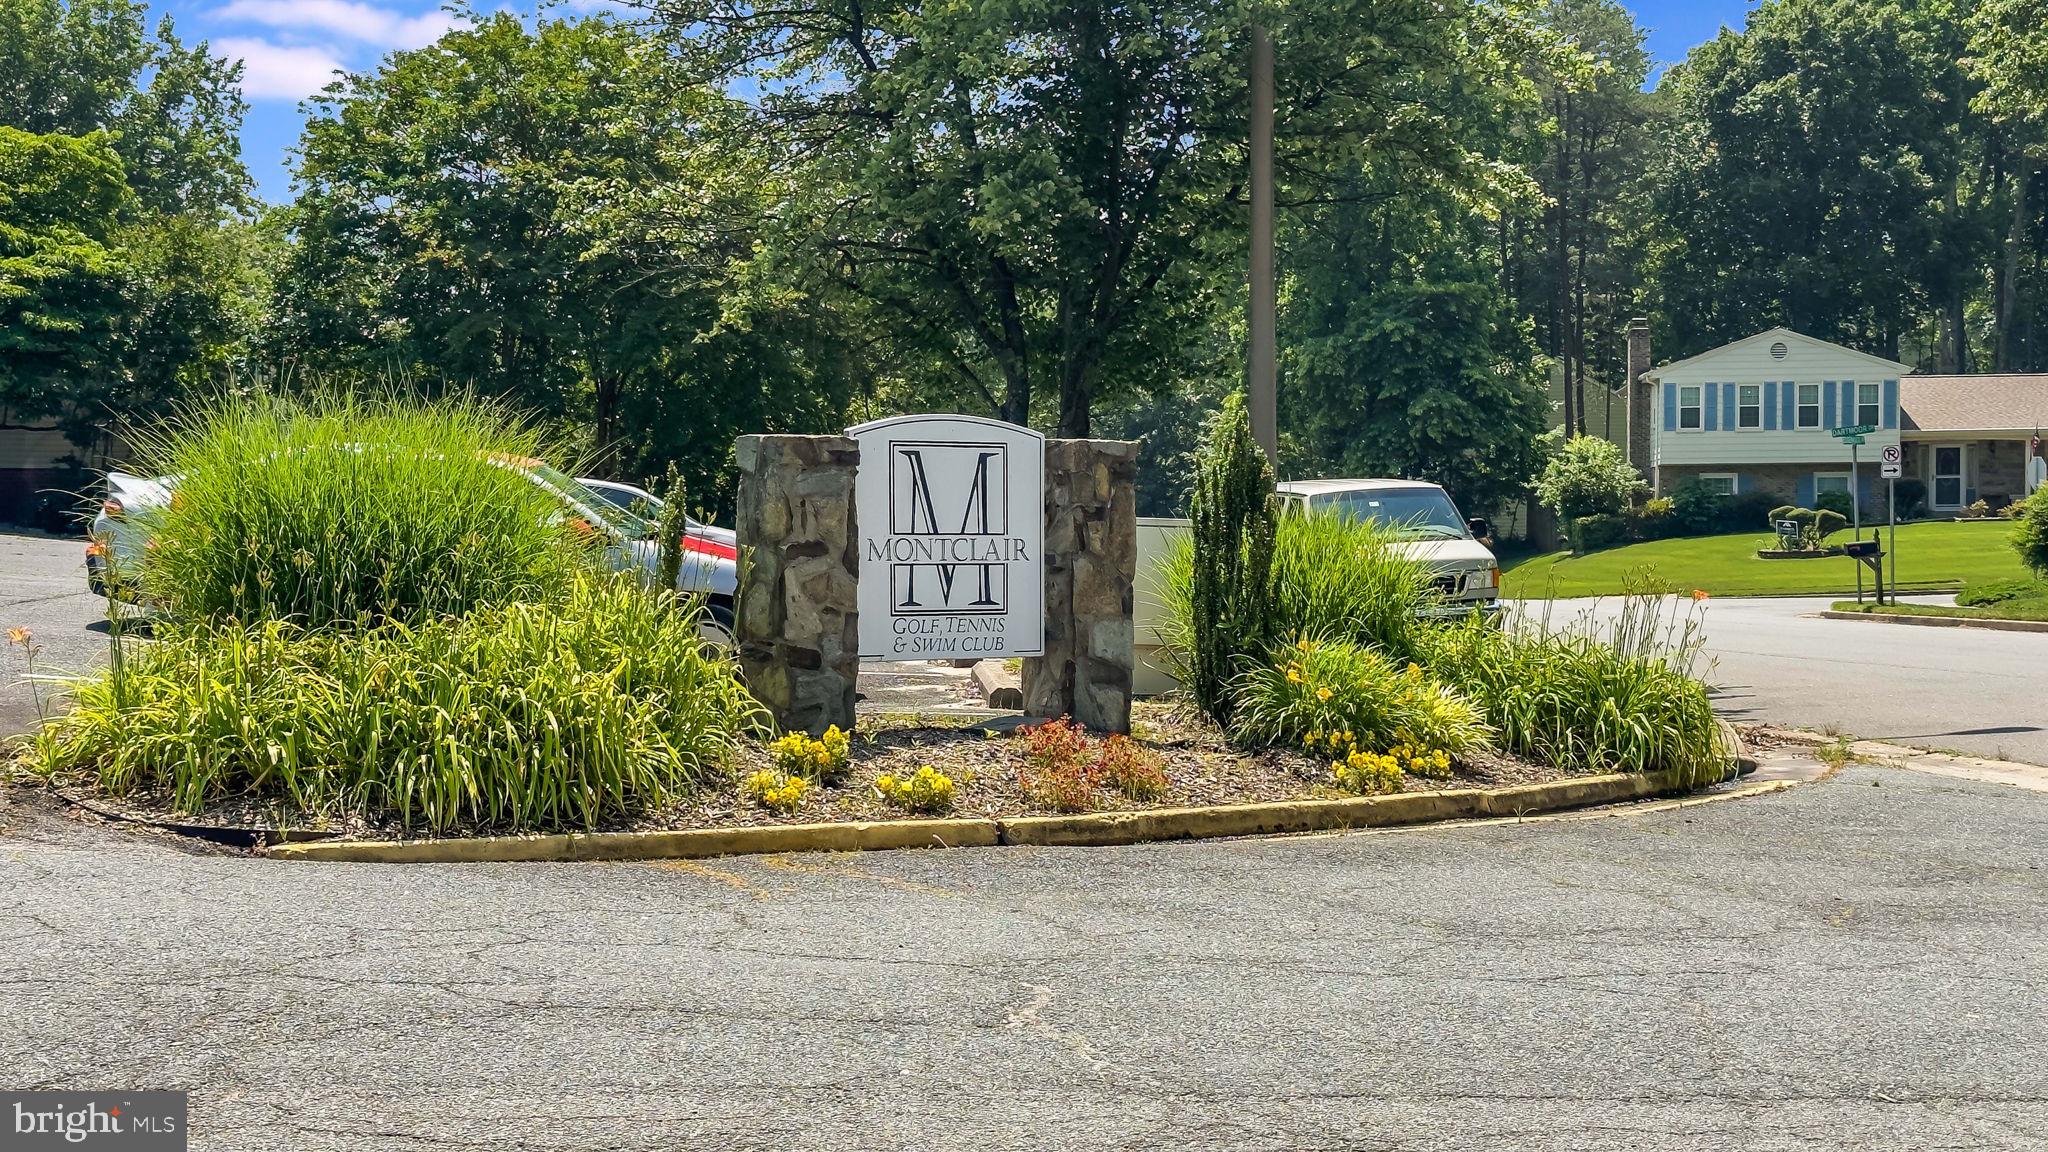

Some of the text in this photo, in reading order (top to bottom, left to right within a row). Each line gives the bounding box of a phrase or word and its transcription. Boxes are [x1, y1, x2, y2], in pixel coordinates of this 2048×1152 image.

[898, 450, 1000, 607] M
[867, 538, 1030, 562] MONTCLAIR
[892, 616, 1006, 636] GOLF, TENNIS
[893, 636, 1005, 653] & SWIM CLUB
